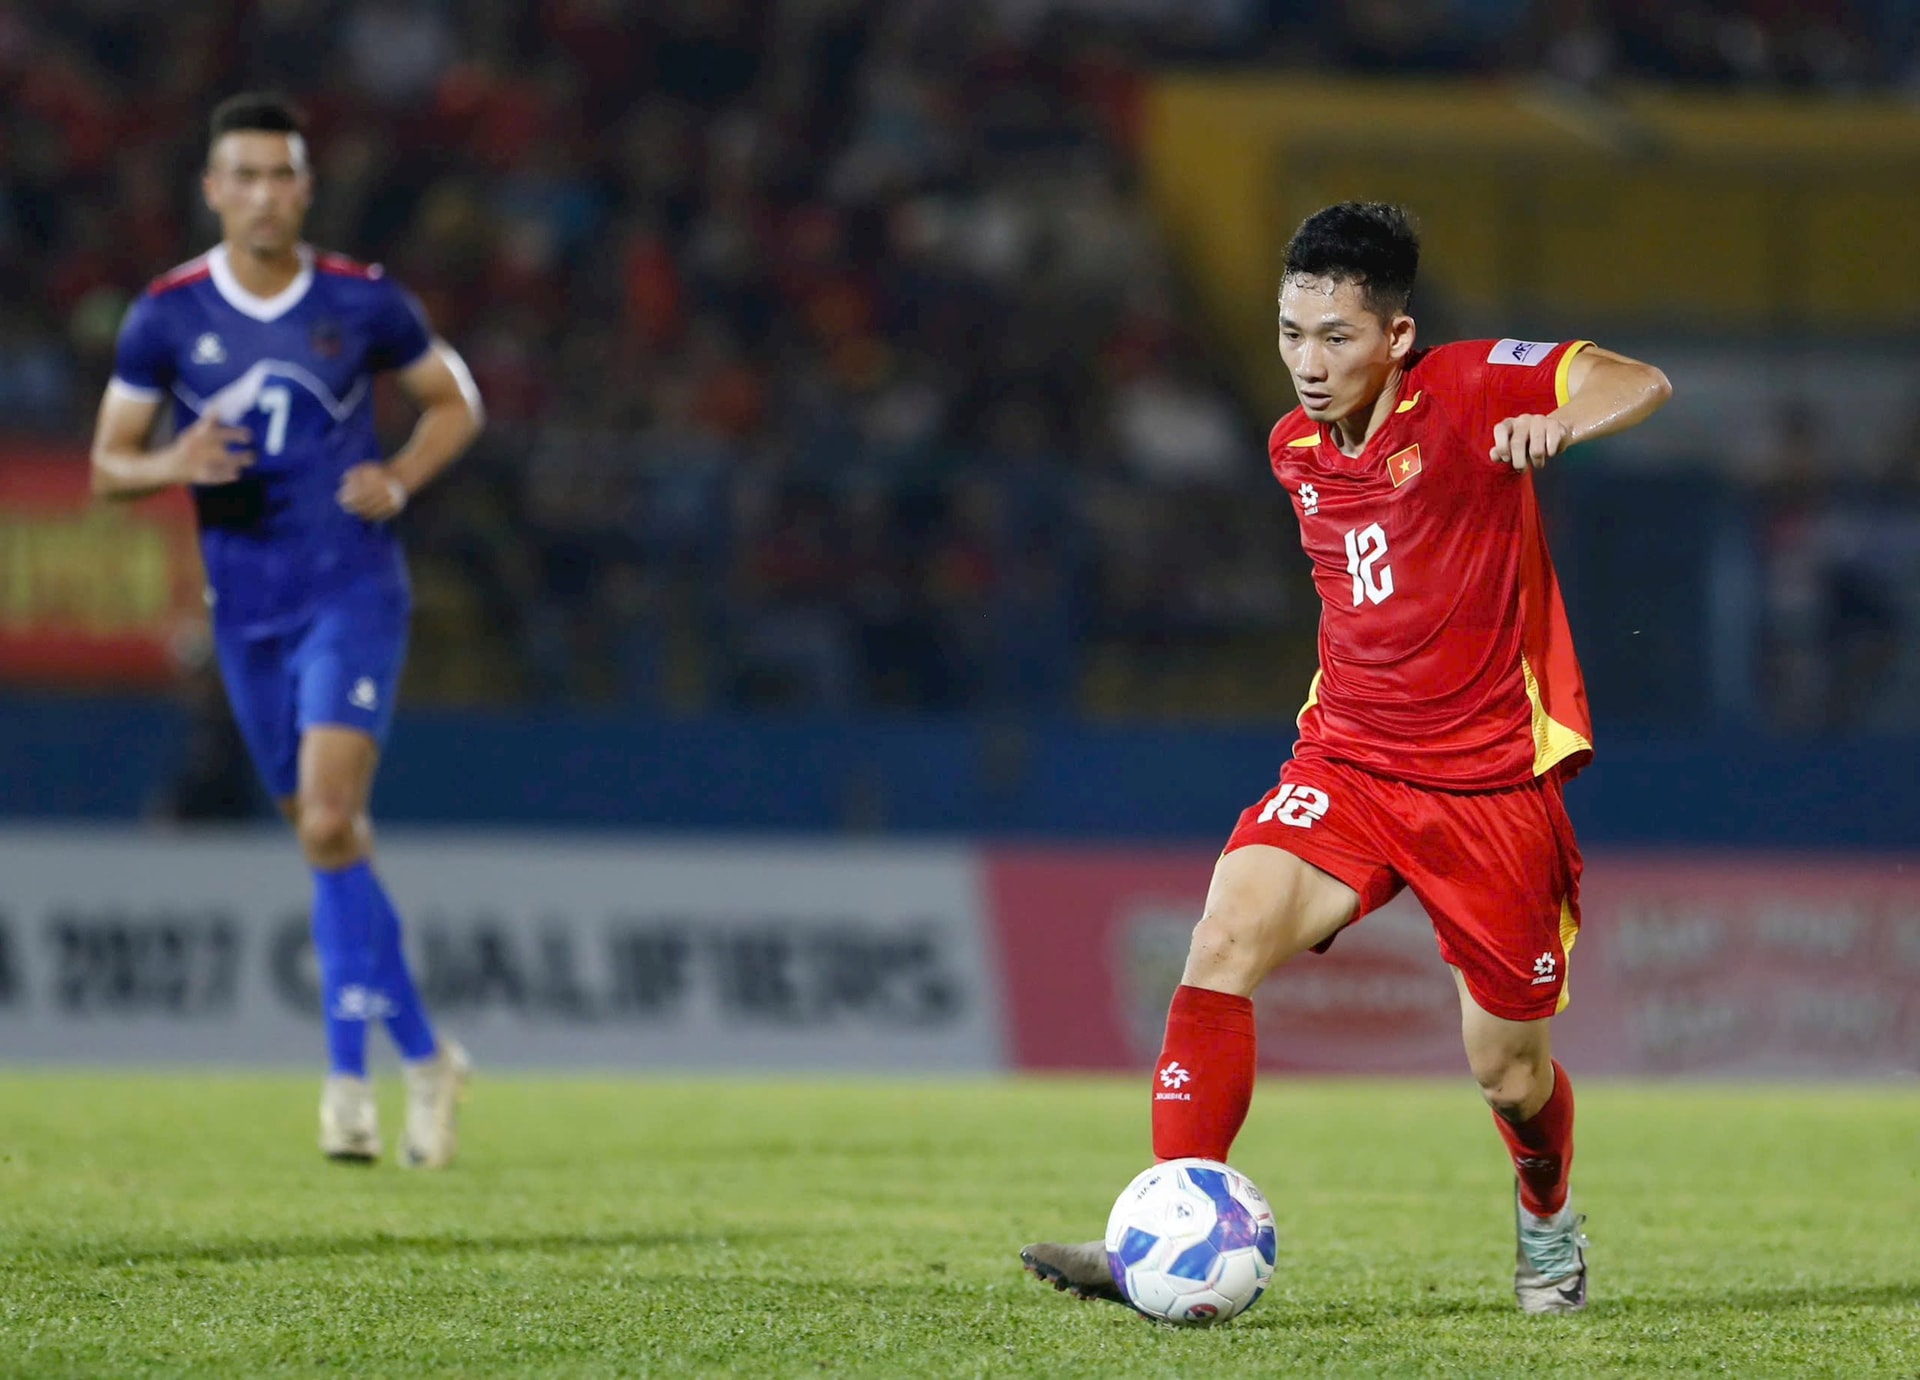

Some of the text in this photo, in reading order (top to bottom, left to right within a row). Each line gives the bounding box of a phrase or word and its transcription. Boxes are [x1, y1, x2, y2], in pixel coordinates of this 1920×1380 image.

[260, 386, 291, 455] 7
[1344, 522, 1395, 607] 12
[1257, 783, 1330, 828] 12
